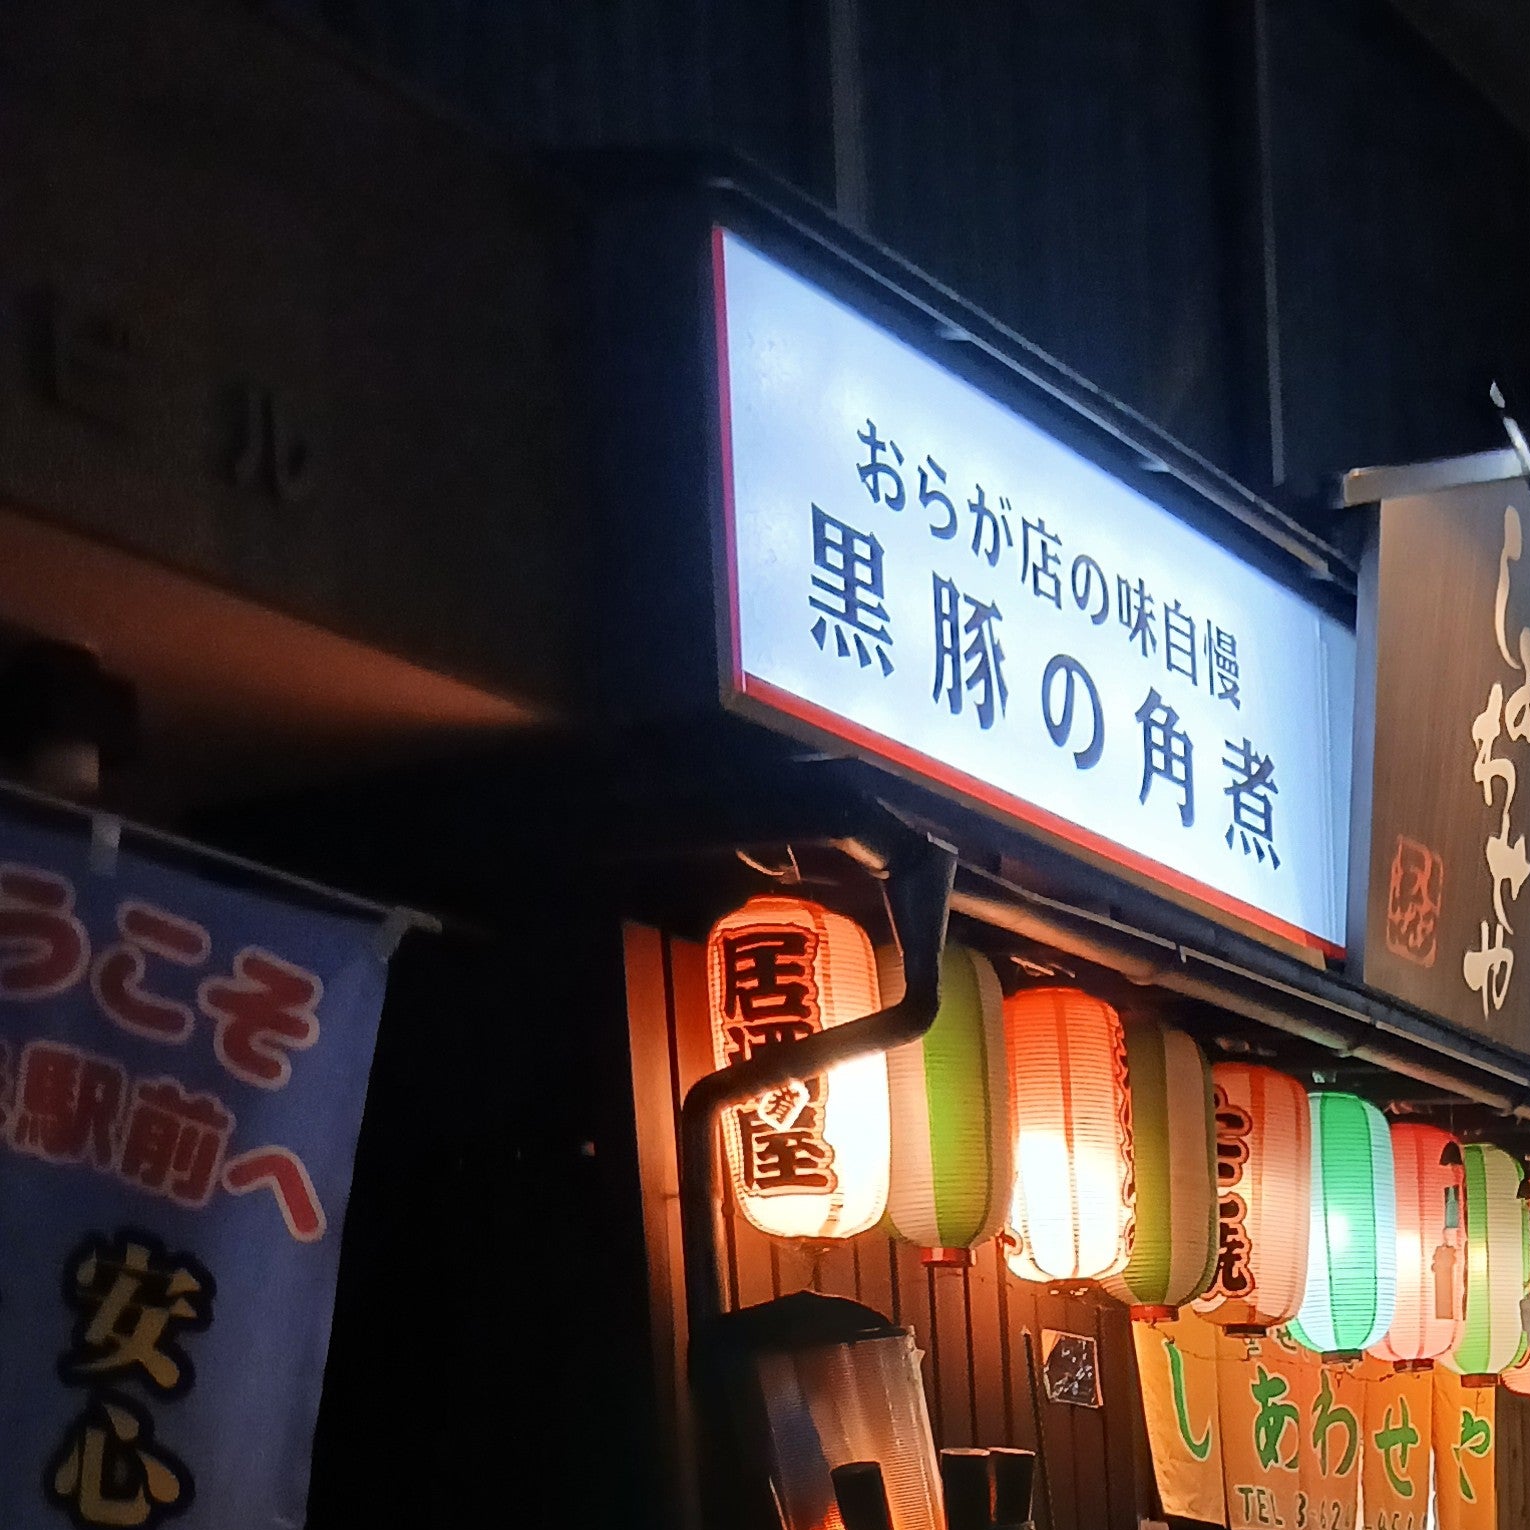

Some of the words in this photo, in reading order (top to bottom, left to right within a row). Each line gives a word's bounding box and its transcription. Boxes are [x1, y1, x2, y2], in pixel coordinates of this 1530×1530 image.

[856, 417, 1242, 711] おらが店の味自慢
[808, 501, 1282, 871] 黒豚の角煮
[0, 1038, 327, 1242] 駅前へ
[1163, 1337, 1495, 1504] しあわせや
[1235, 1485, 1286, 1527] TEL
